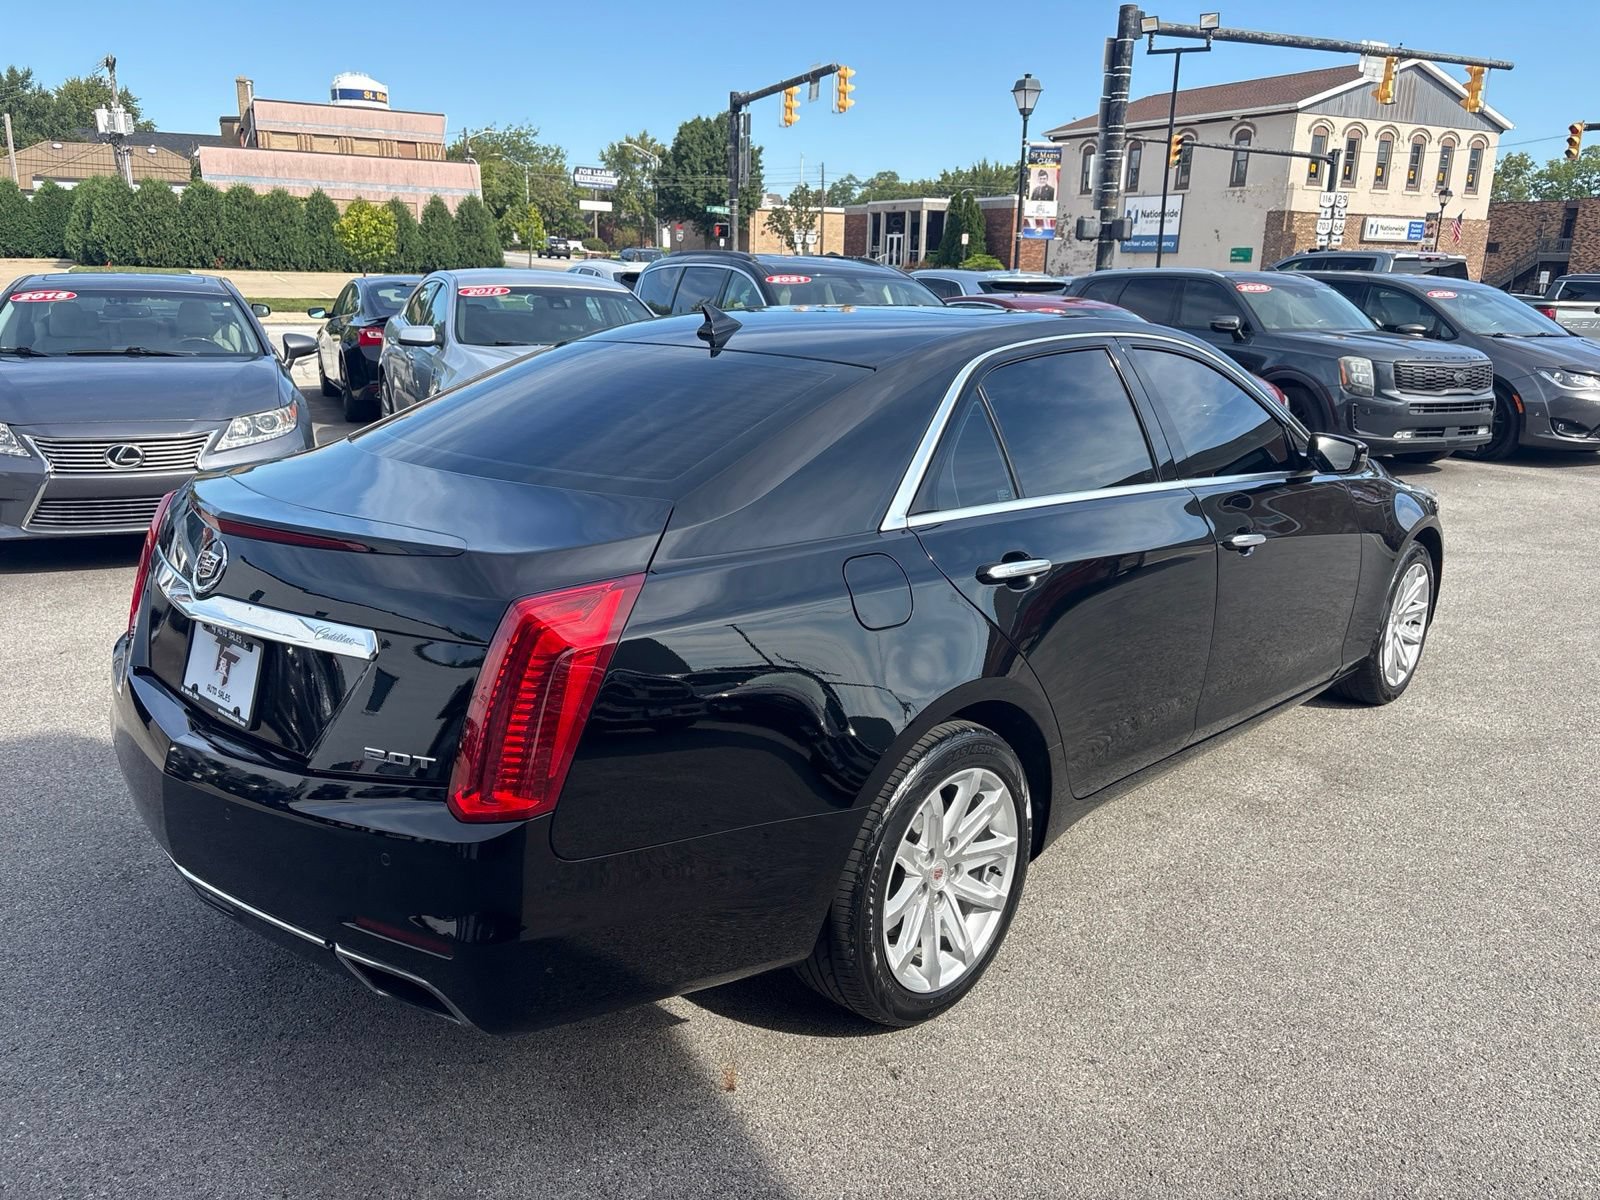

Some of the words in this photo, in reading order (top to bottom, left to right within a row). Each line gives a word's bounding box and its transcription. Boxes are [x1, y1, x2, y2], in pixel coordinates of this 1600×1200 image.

[578, 167, 592, 175] FOR
[593, 169, 615, 177] LEASE
[1322, 194, 1332, 203] 116
[1337, 195, 1348, 205] 29
[1319, 222, 1330, 231] 703
[1334, 223, 1344, 231] 66
[1380, 224, 1406, 232] Nationwide
[20, 291, 68, 300] 2015
[468, 287, 502, 295] 2015
[314, 625, 365, 646] Cadillac
[206, 683, 218, 696] AUTO
[217, 689, 231, 703] SALES
